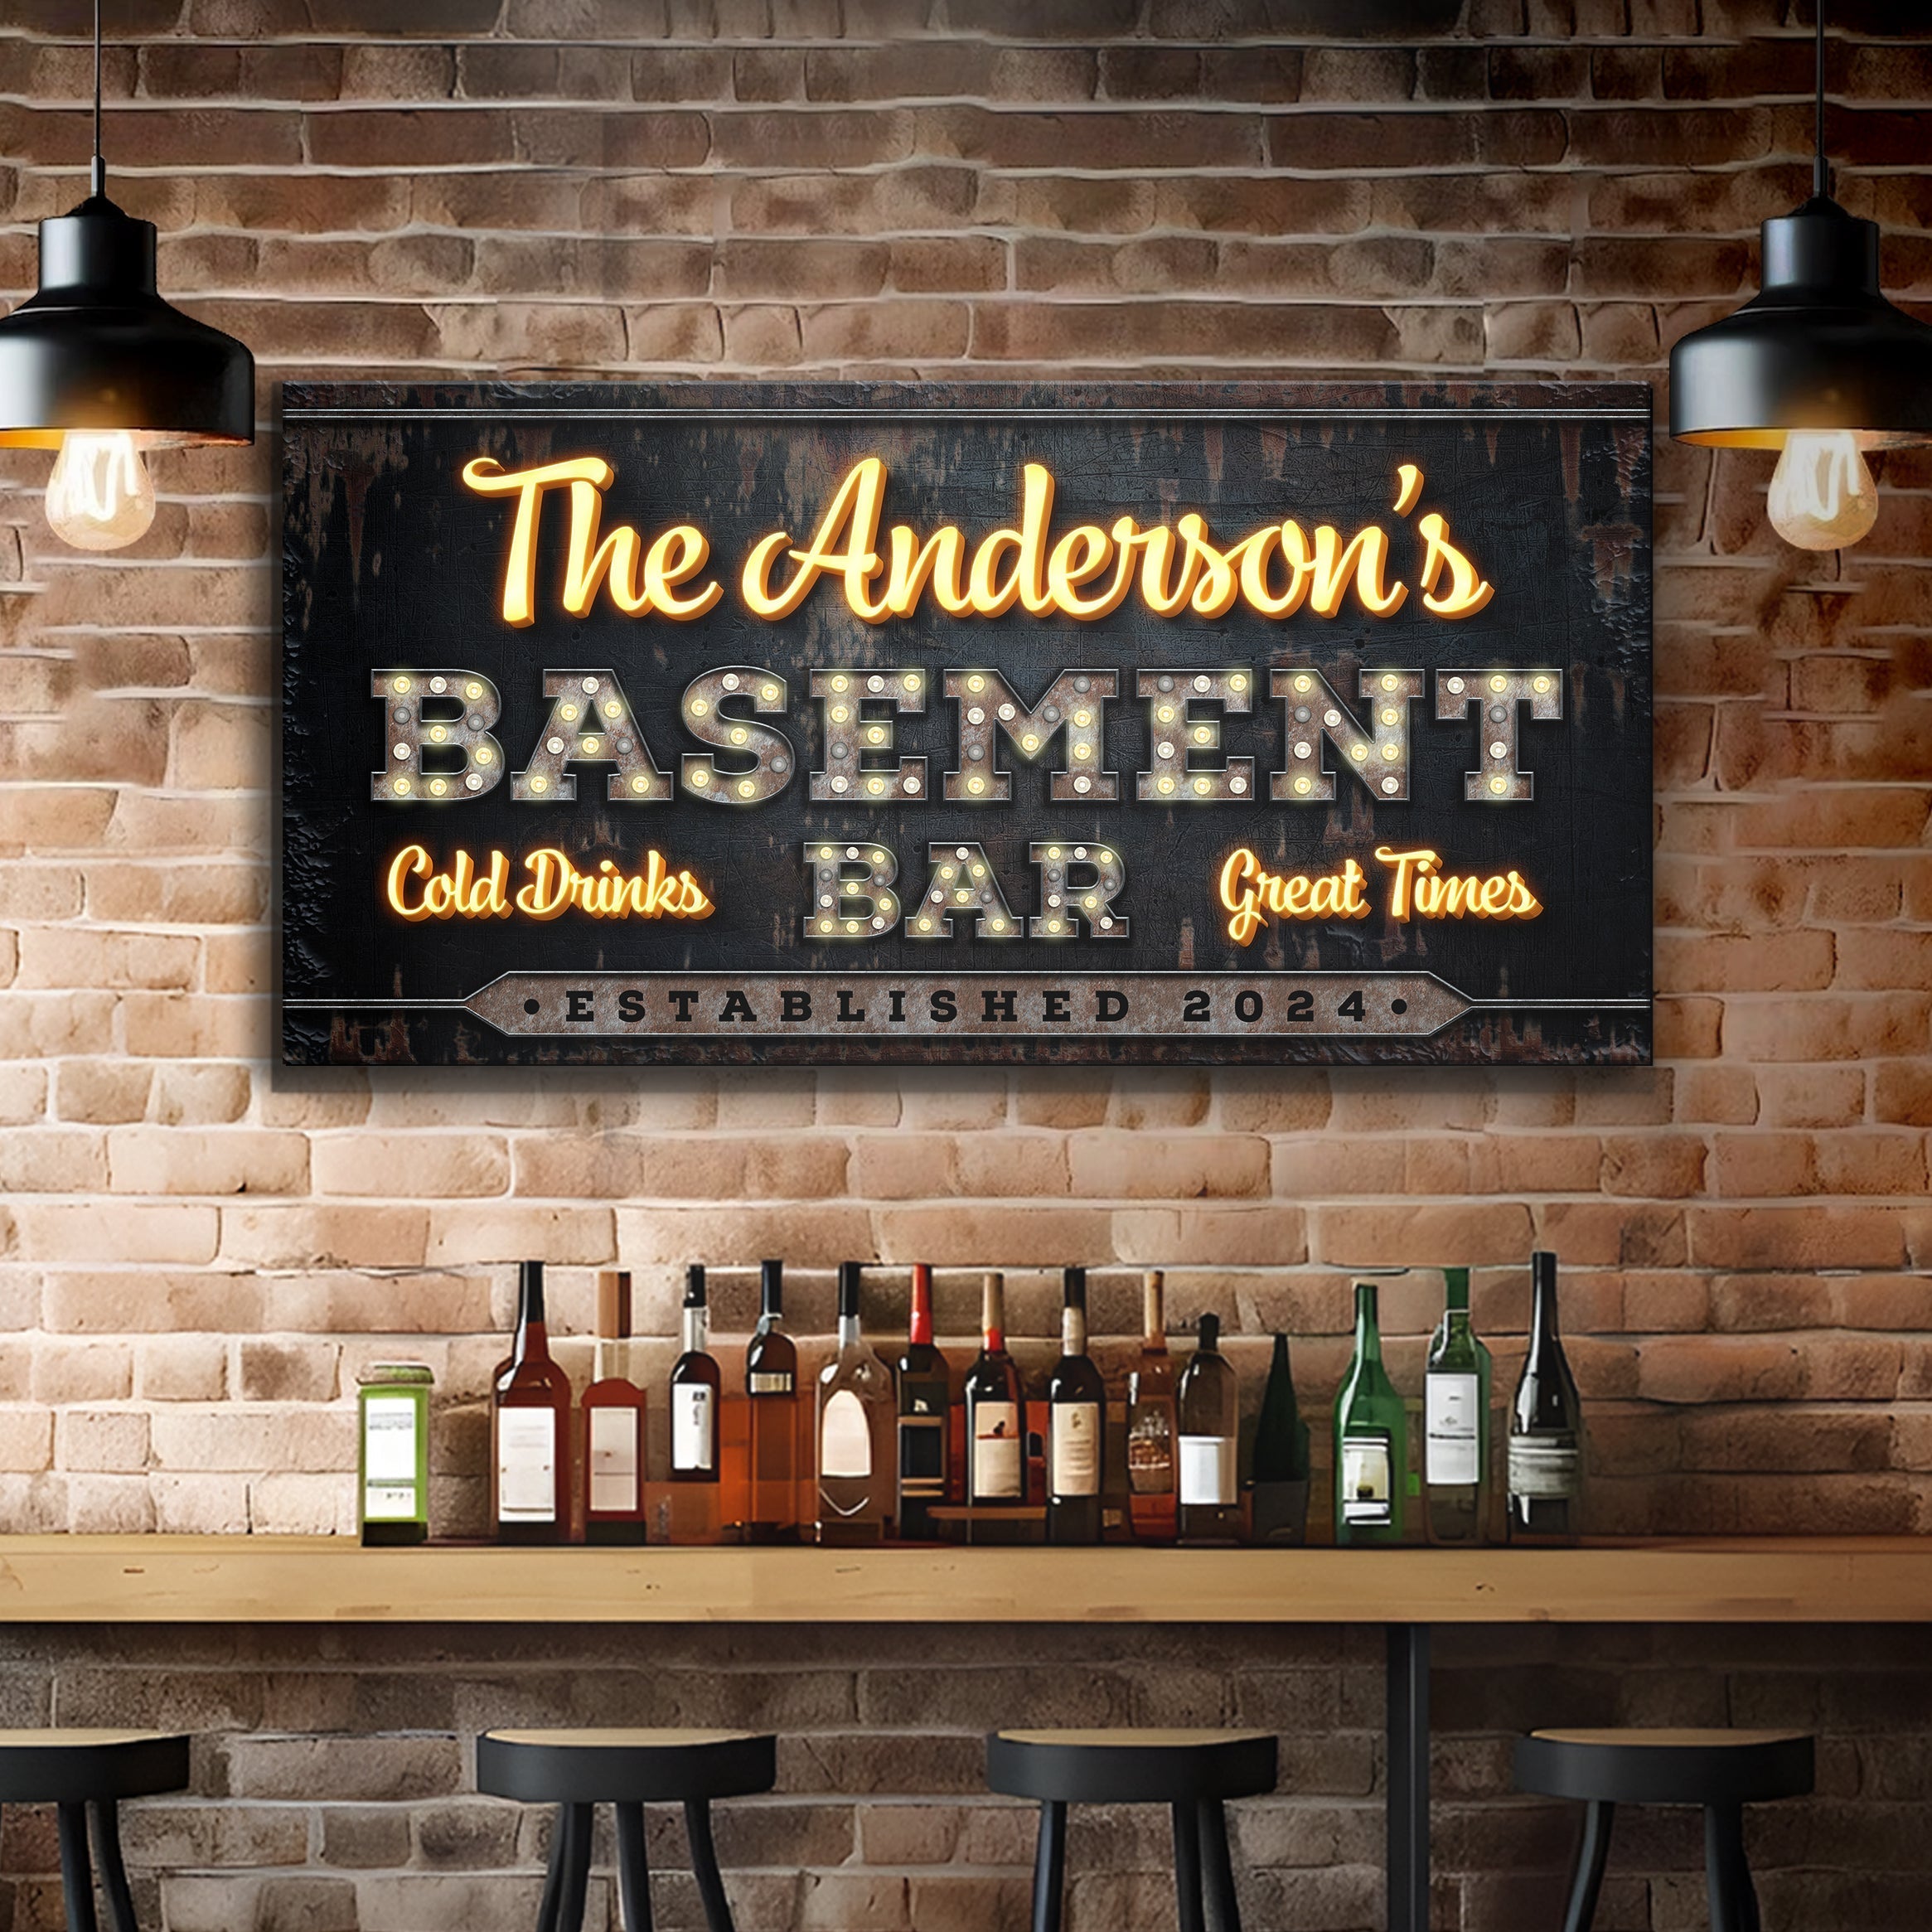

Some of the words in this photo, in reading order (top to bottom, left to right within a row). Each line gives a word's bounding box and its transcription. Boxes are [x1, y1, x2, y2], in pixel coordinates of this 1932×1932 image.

[462, 458, 723, 627] The
[743, 458, 1494, 625] Anderson's
[370, 666, 1563, 802] BASEMENT
[387, 845, 514, 922] Cold
[516, 848, 715, 920] Drinks
[803, 842, 1130, 937] BAR
[1220, 847, 1371, 947] Great
[1375, 846, 1543, 923] Times
[565, 990, 1130, 1023] ESTABLISHED
[1183, 990, 1366, 1023] 2024
